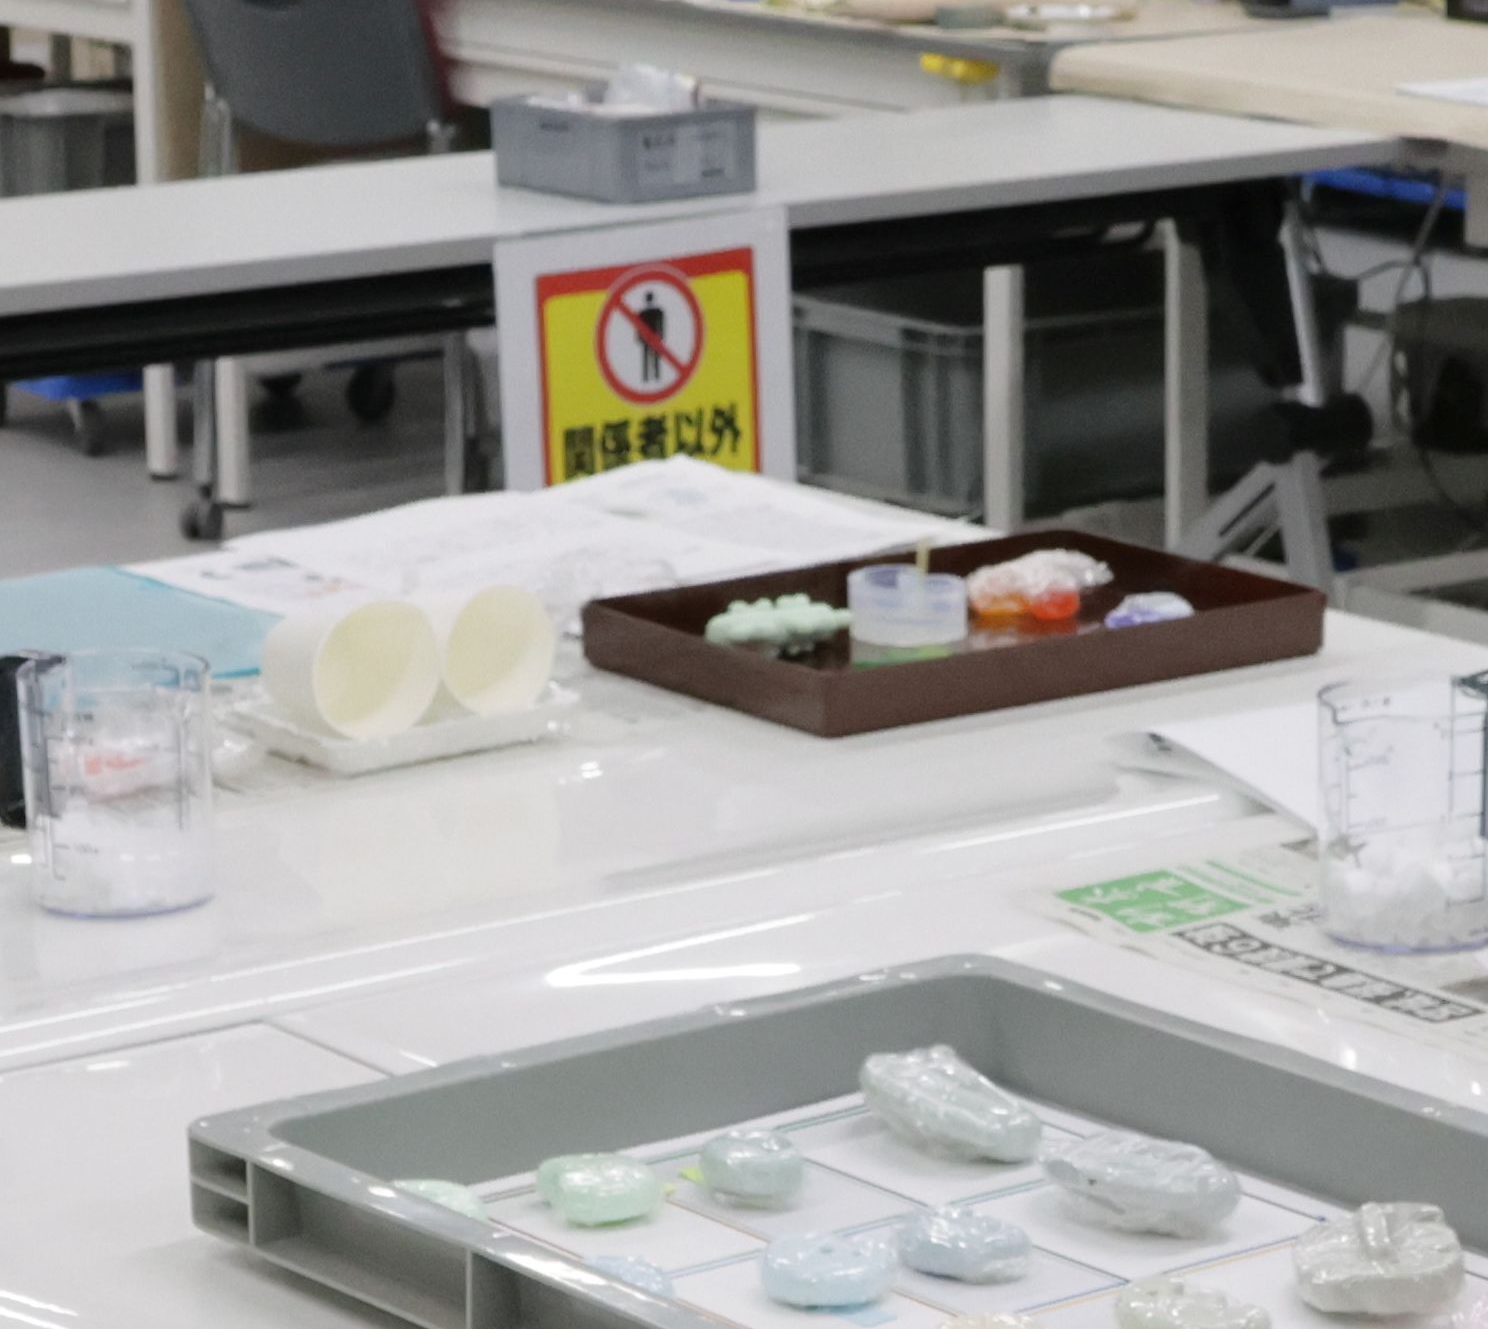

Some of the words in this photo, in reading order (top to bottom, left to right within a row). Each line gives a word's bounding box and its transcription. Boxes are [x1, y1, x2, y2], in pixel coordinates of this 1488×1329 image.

[562, 403, 743, 478] 関係者以外
